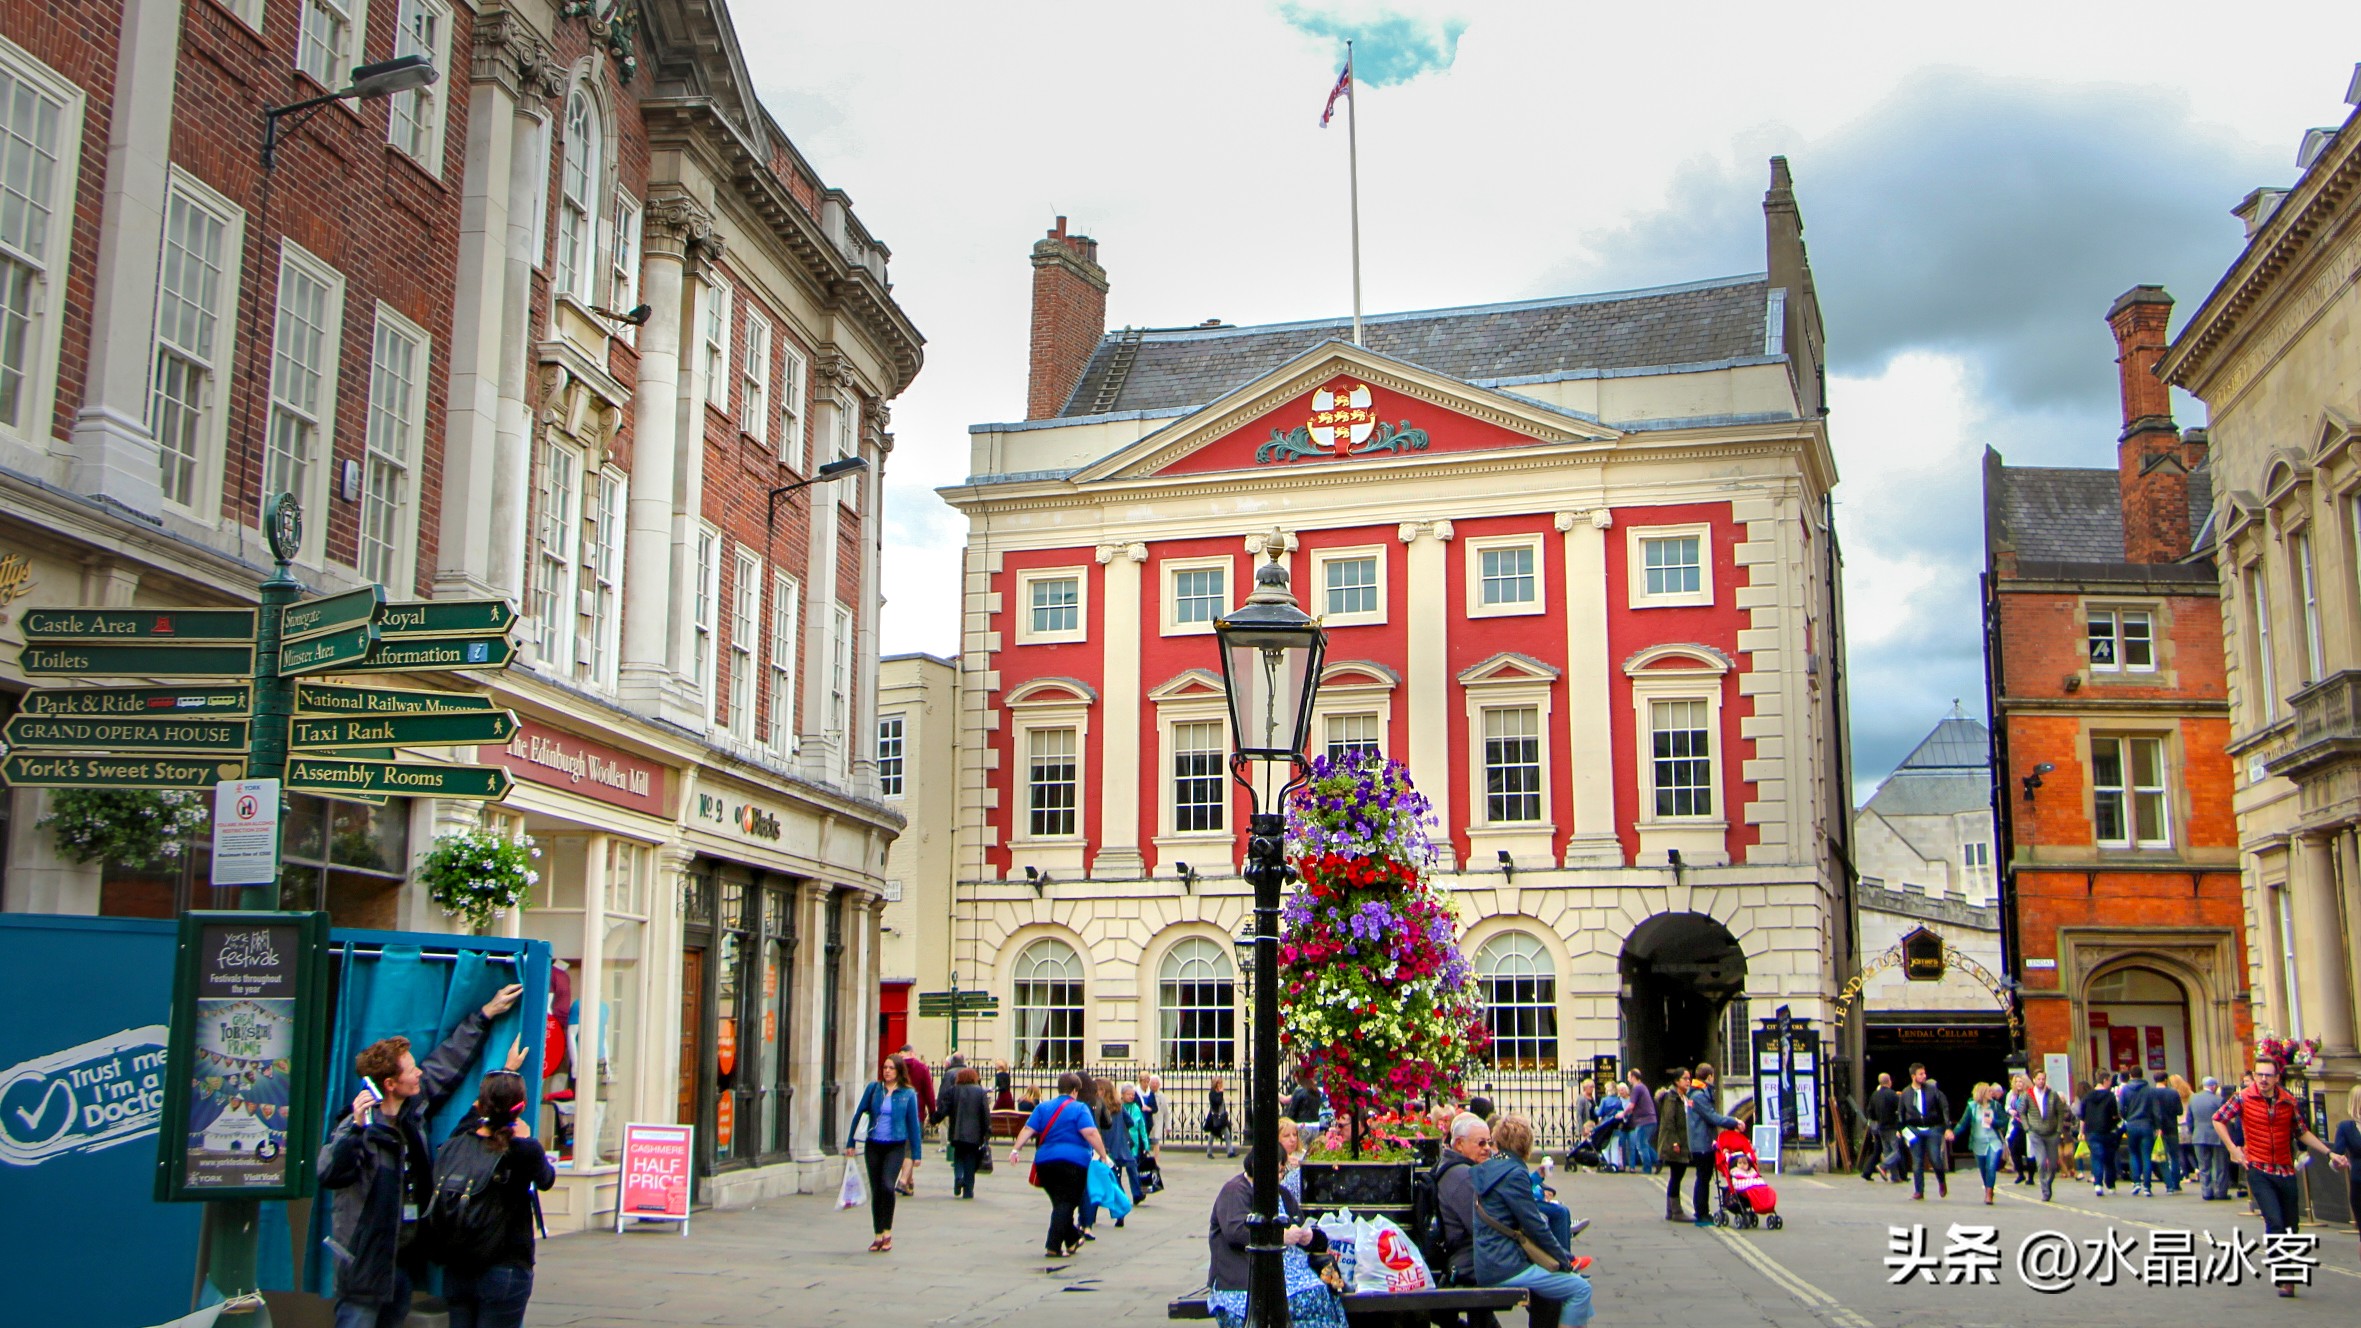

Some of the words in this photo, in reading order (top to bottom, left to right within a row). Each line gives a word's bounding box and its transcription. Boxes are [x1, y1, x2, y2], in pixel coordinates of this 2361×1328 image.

[0, 553, 39, 606] ttys
[29, 614, 84, 633] Castle
[89, 616, 136, 633] Area
[285, 610, 321, 630] Stonegate
[378, 607, 426, 630] Royal
[29, 651, 88, 669] Toilets
[283, 649, 313, 667] Minster
[314, 643, 335, 661] Area
[363, 646, 461, 665] nformation
[35, 696, 78, 714] Park
[81, 695, 99, 712] &
[101, 694, 145, 711] Ride
[299, 690, 363, 710] National
[367, 695, 422, 712] Railway
[425, 699, 484, 712] Mus
[20, 724, 91, 740] GRAND
[95, 725, 159, 741] OPERA
[164, 727, 230, 742] HOUSE
[296, 723, 338, 742] Taxi
[347, 721, 395, 740] Rank
[17, 758, 80, 778] York's
[87, 760, 149, 780] Sweet
[154, 762, 210, 785] Story
[292, 762, 375, 789] Assembly
[383, 766, 443, 787] Rooms
[529, 735, 586, 784] Edinburgh
[587, 754, 626, 789] Woollen
[629, 768, 649, 797] Mill
[715, 799, 723, 823] 2
[751, 807, 781, 841] Blacks
[217, 946, 280, 969] festivals
[210, 973, 242, 983] Festivals
[243, 974, 282, 985] throughout
[231, 985, 243, 993] the
[244, 986, 262, 995] year
[1897, 1027, 1935, 1038] LENDAL
[1936, 1027, 1979, 1038] CELLARS
[69, 1057, 122, 1089] Trust
[132, 1049, 168, 1073] me
[94, 1080, 135, 1103] I'm
[143, 1073, 160, 1090] a
[83, 1088, 165, 1128] Docto
[630, 1143, 685, 1155] CASHMERE
[633, 1157, 682, 1174] HALF
[198, 1175, 222, 1183] YORK
[1386, 1266, 1424, 1286] SALE
